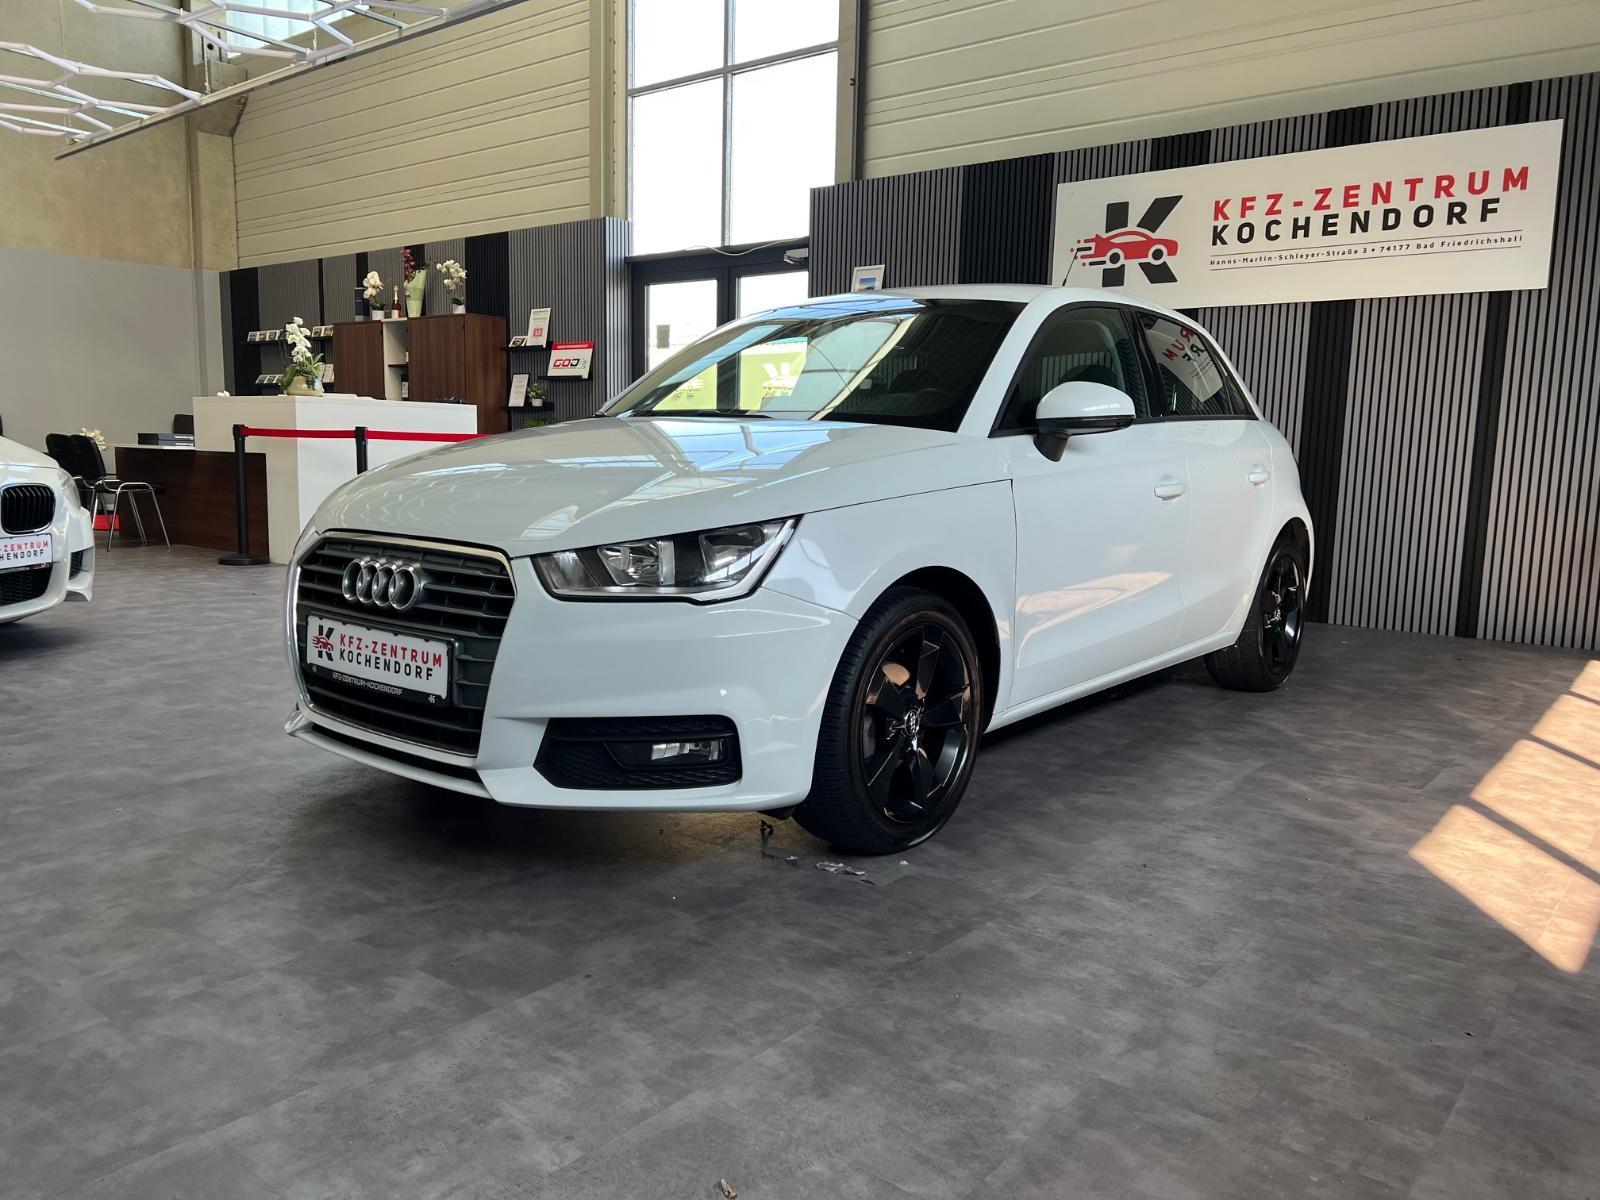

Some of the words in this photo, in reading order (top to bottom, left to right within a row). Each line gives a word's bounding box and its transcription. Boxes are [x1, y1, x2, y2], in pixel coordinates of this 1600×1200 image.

[1213, 166, 1529, 222] KFZ-ZENTRUM
[1211, 198, 1501, 246] KOCHENDORF
[1210, 248, 1359, 266] Hanns-Martin-Schleyer-Straße
[1380, 244, 1411, 253] 74177
[1416, 241, 1435, 250] Bad
[1441, 235, 1524, 247] Friedrichshall
[340, 633, 442, 667] KFZ-ZENTRUM
[340, 648, 433, 681] KOCHENDORF
